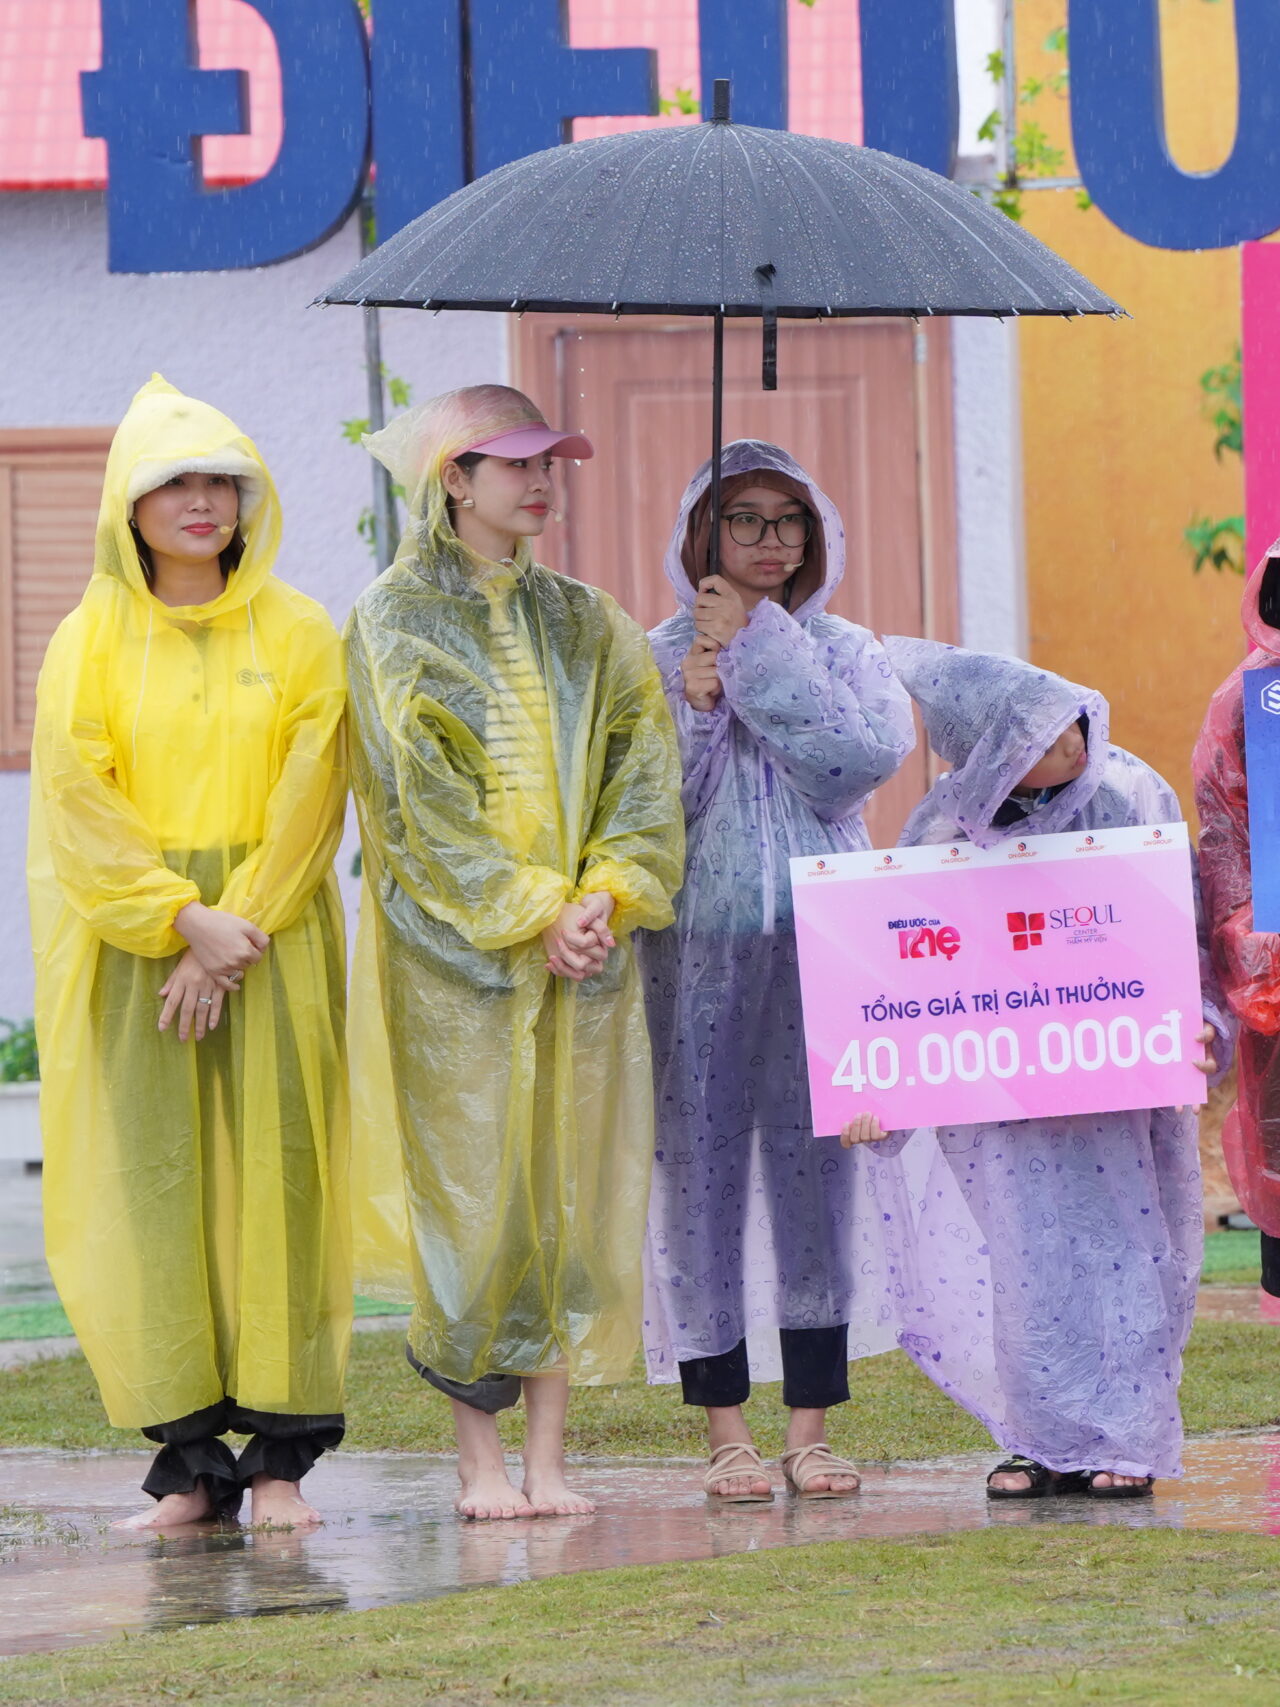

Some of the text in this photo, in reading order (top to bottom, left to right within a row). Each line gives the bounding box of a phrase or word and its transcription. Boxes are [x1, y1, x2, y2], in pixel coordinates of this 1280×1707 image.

[1050, 904, 1122, 930] SEOUL
[898, 926, 961, 961] mẹ
[861, 976, 1145, 1023] TỔNG GIÁ TRỊ GIẢI THƯỞNG
[831, 1009, 1184, 1093] 40.000.000đ
